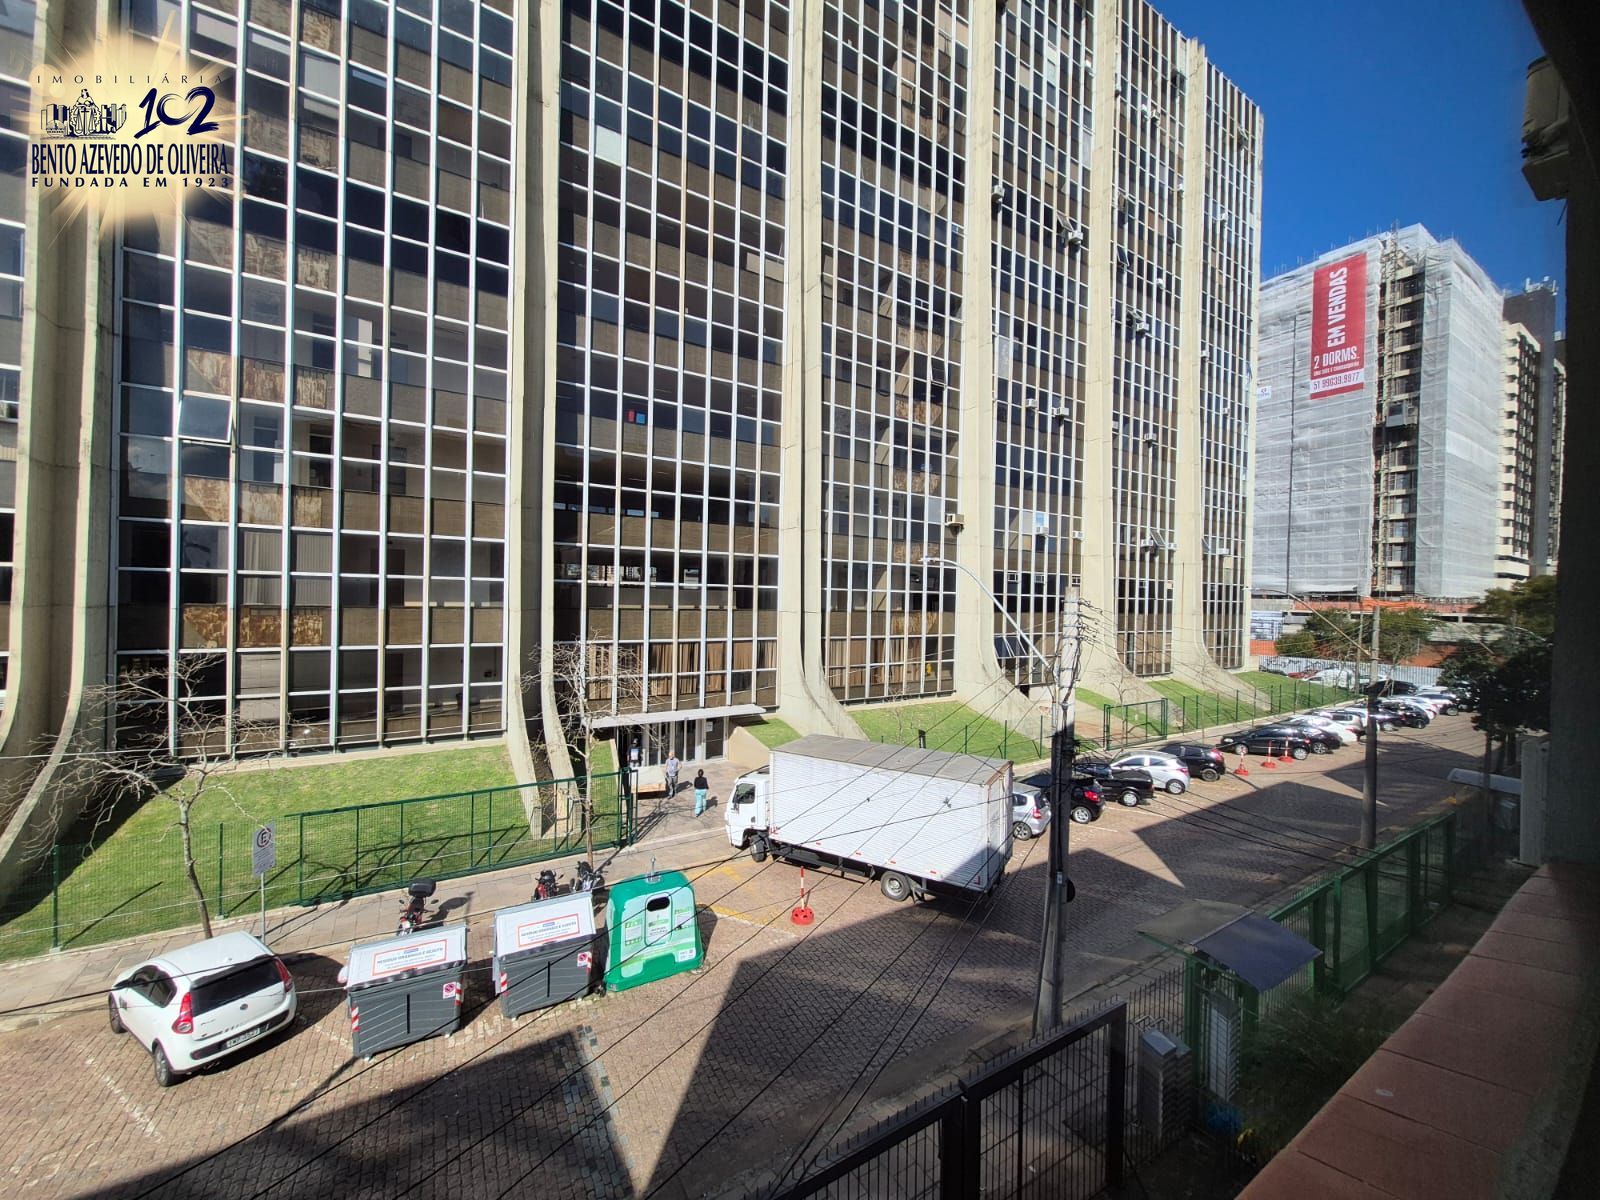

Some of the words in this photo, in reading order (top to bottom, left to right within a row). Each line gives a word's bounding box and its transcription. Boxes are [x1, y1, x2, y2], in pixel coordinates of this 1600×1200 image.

[1328, 267, 1348, 327] VENDAS
[1327, 324, 1346, 348] EM
[1313, 355, 1320, 370] 2
